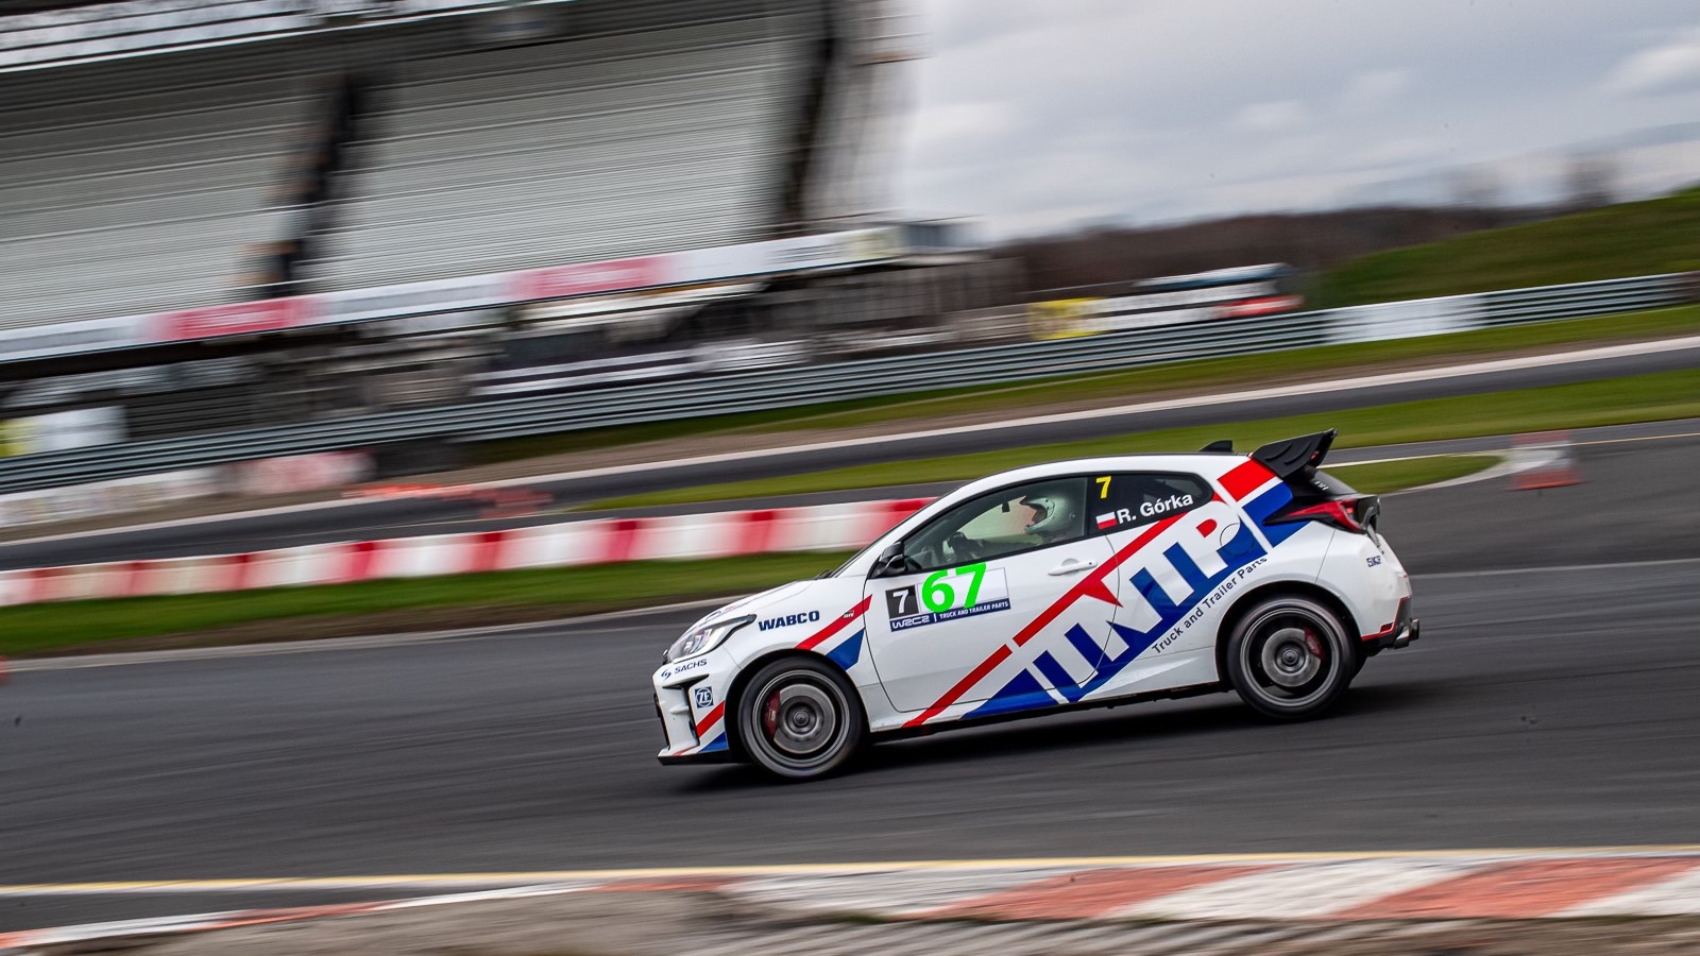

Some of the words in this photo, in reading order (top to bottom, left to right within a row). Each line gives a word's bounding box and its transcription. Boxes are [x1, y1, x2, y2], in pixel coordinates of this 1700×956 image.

[1096, 476, 1112, 499] 7
[1117, 508, 1137, 524] R.
[1140, 494, 1194, 517] Górka
[892, 589, 909, 614] 7
[921, 562, 987, 613] 67
[891, 615, 930, 629] WRC2
[939, 609, 957, 620] TRUCK
[968, 603, 991, 615] TRAILER
[991, 600, 1009, 610] PARTS
[1151, 627, 1184, 654] Truck
[1183, 608, 1204, 629] and
[1202, 577, 1239, 609] Trailer
[1236, 556, 1268, 580] Parts
[758, 610, 820, 632] WABCO
[674, 658, 708, 675] SACHS
[697, 690, 712, 704] ZF
